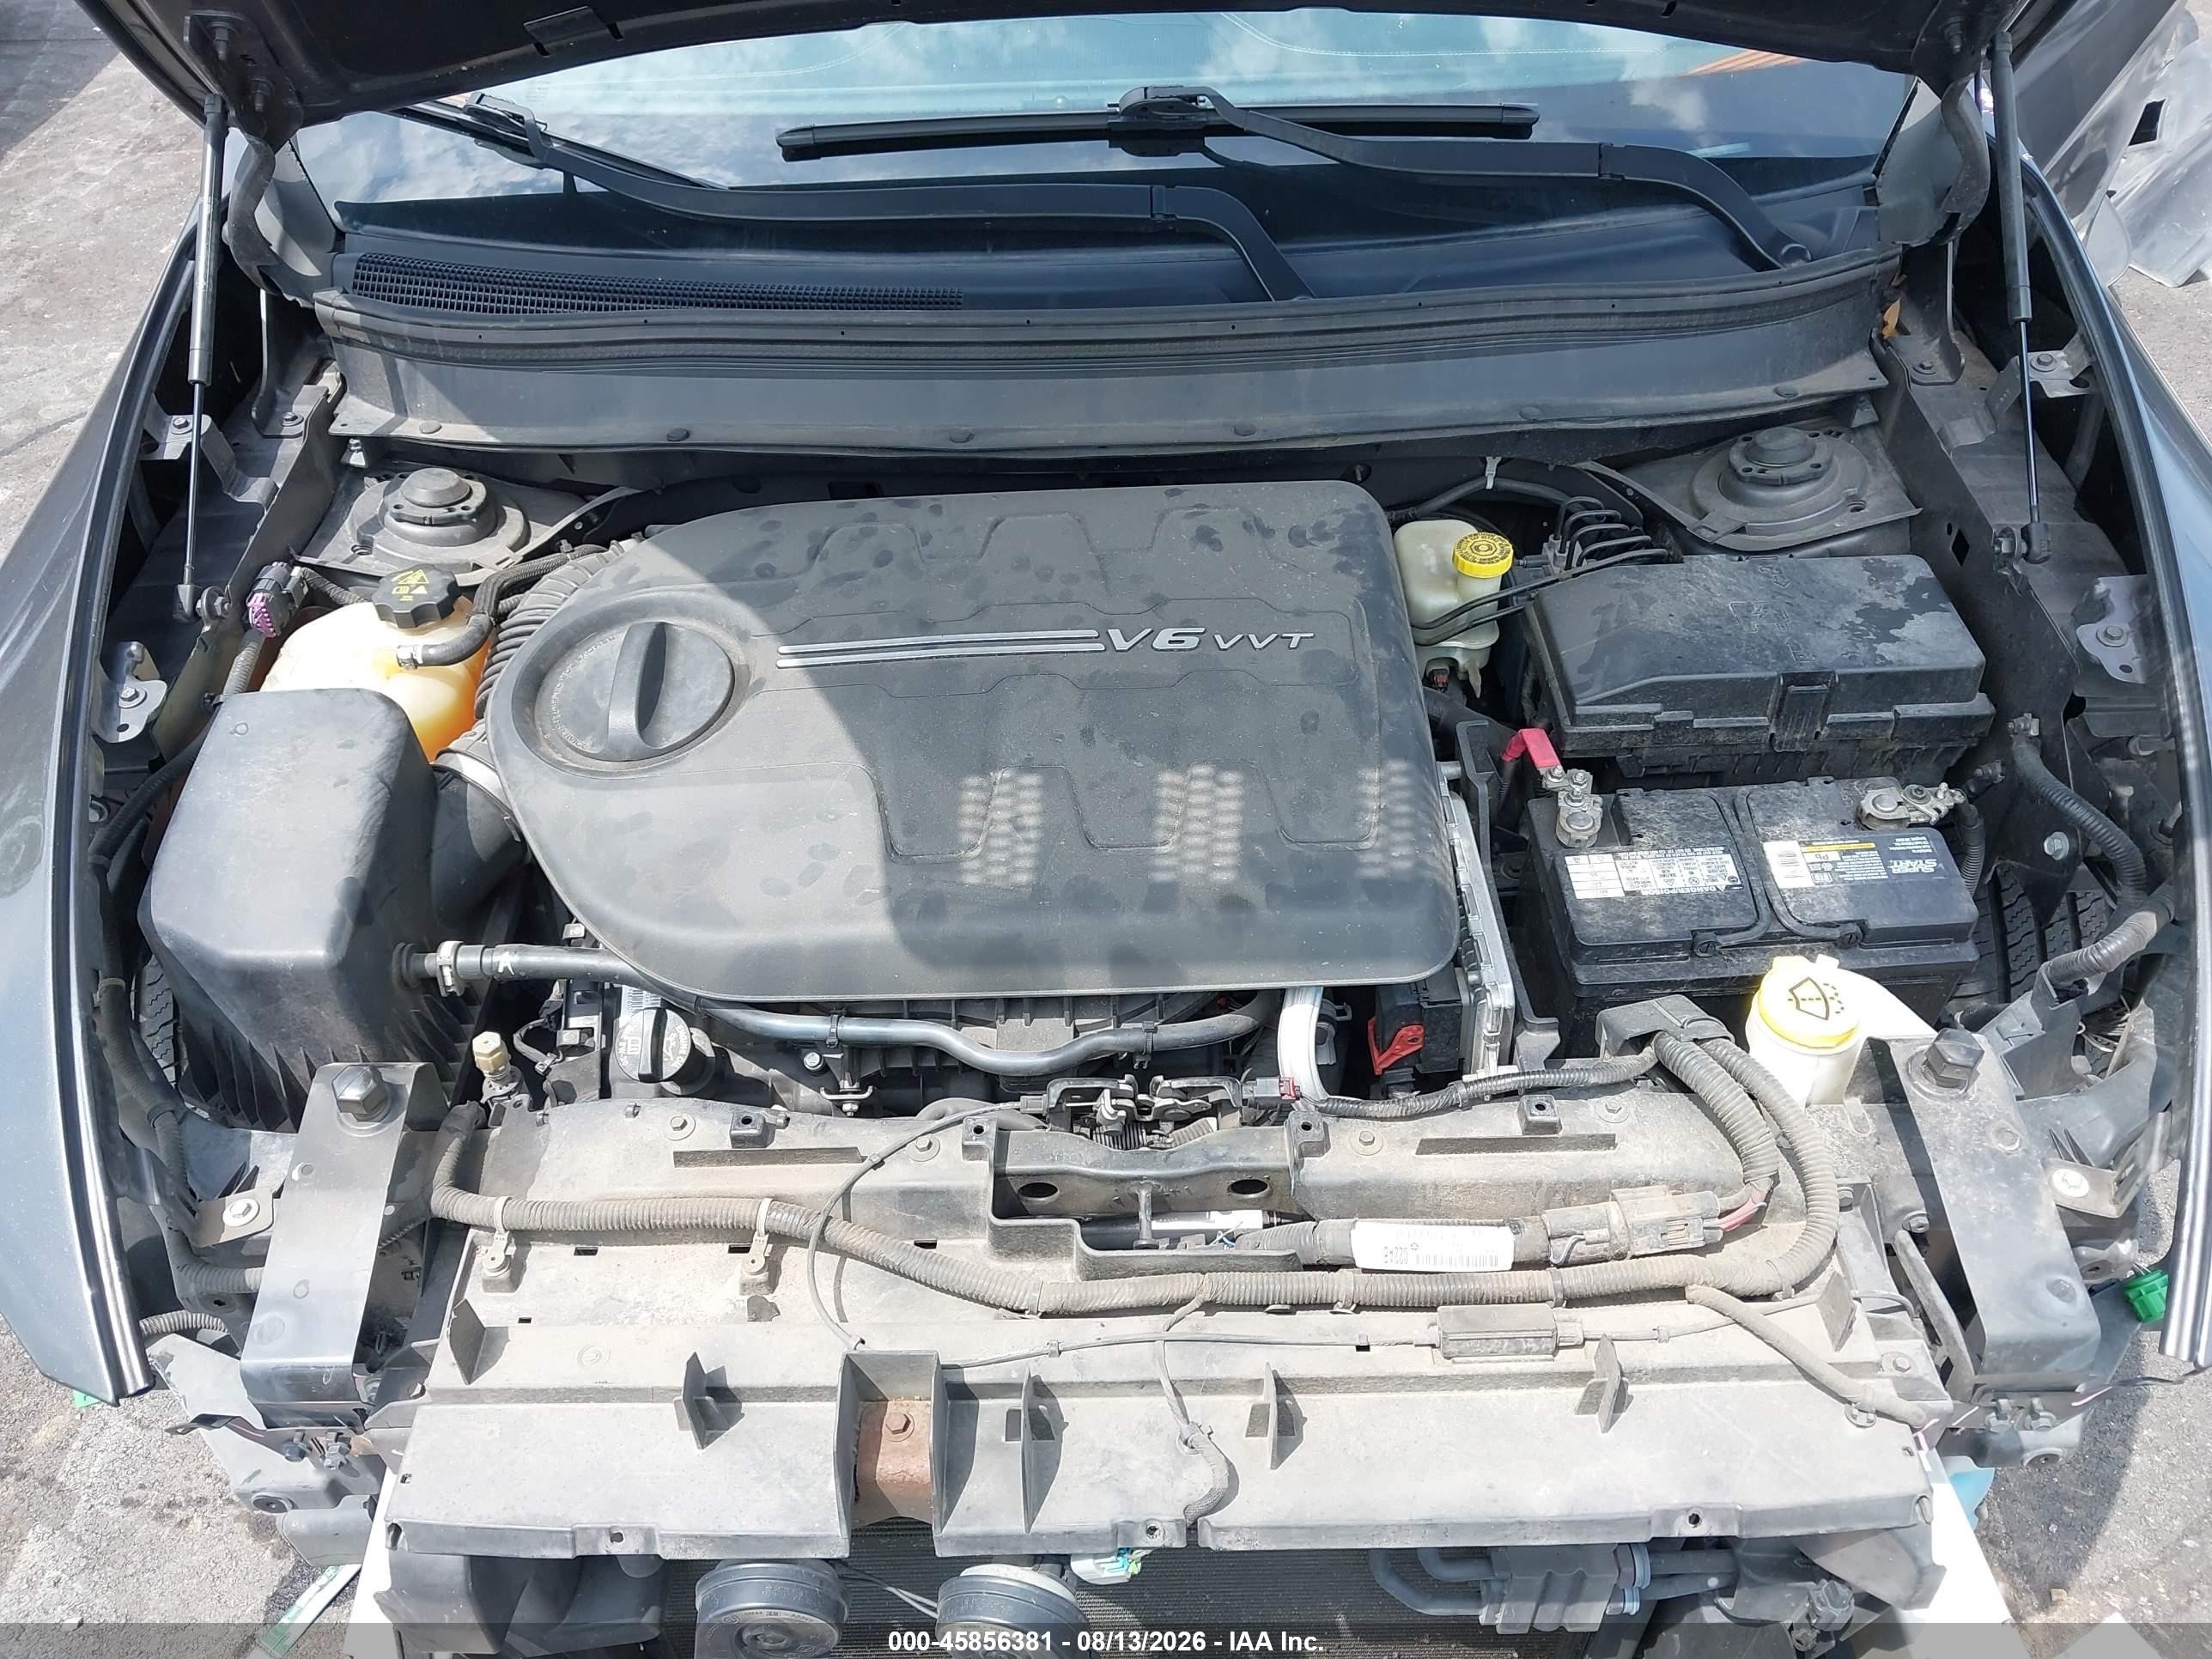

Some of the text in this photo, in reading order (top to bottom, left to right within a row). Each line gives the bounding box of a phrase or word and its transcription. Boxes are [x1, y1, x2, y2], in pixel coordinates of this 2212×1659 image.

[1106, 627, 1315, 653] V6 VVT
[1893, 858, 1938, 867] START
[1891, 866, 1936, 874] SUPER
